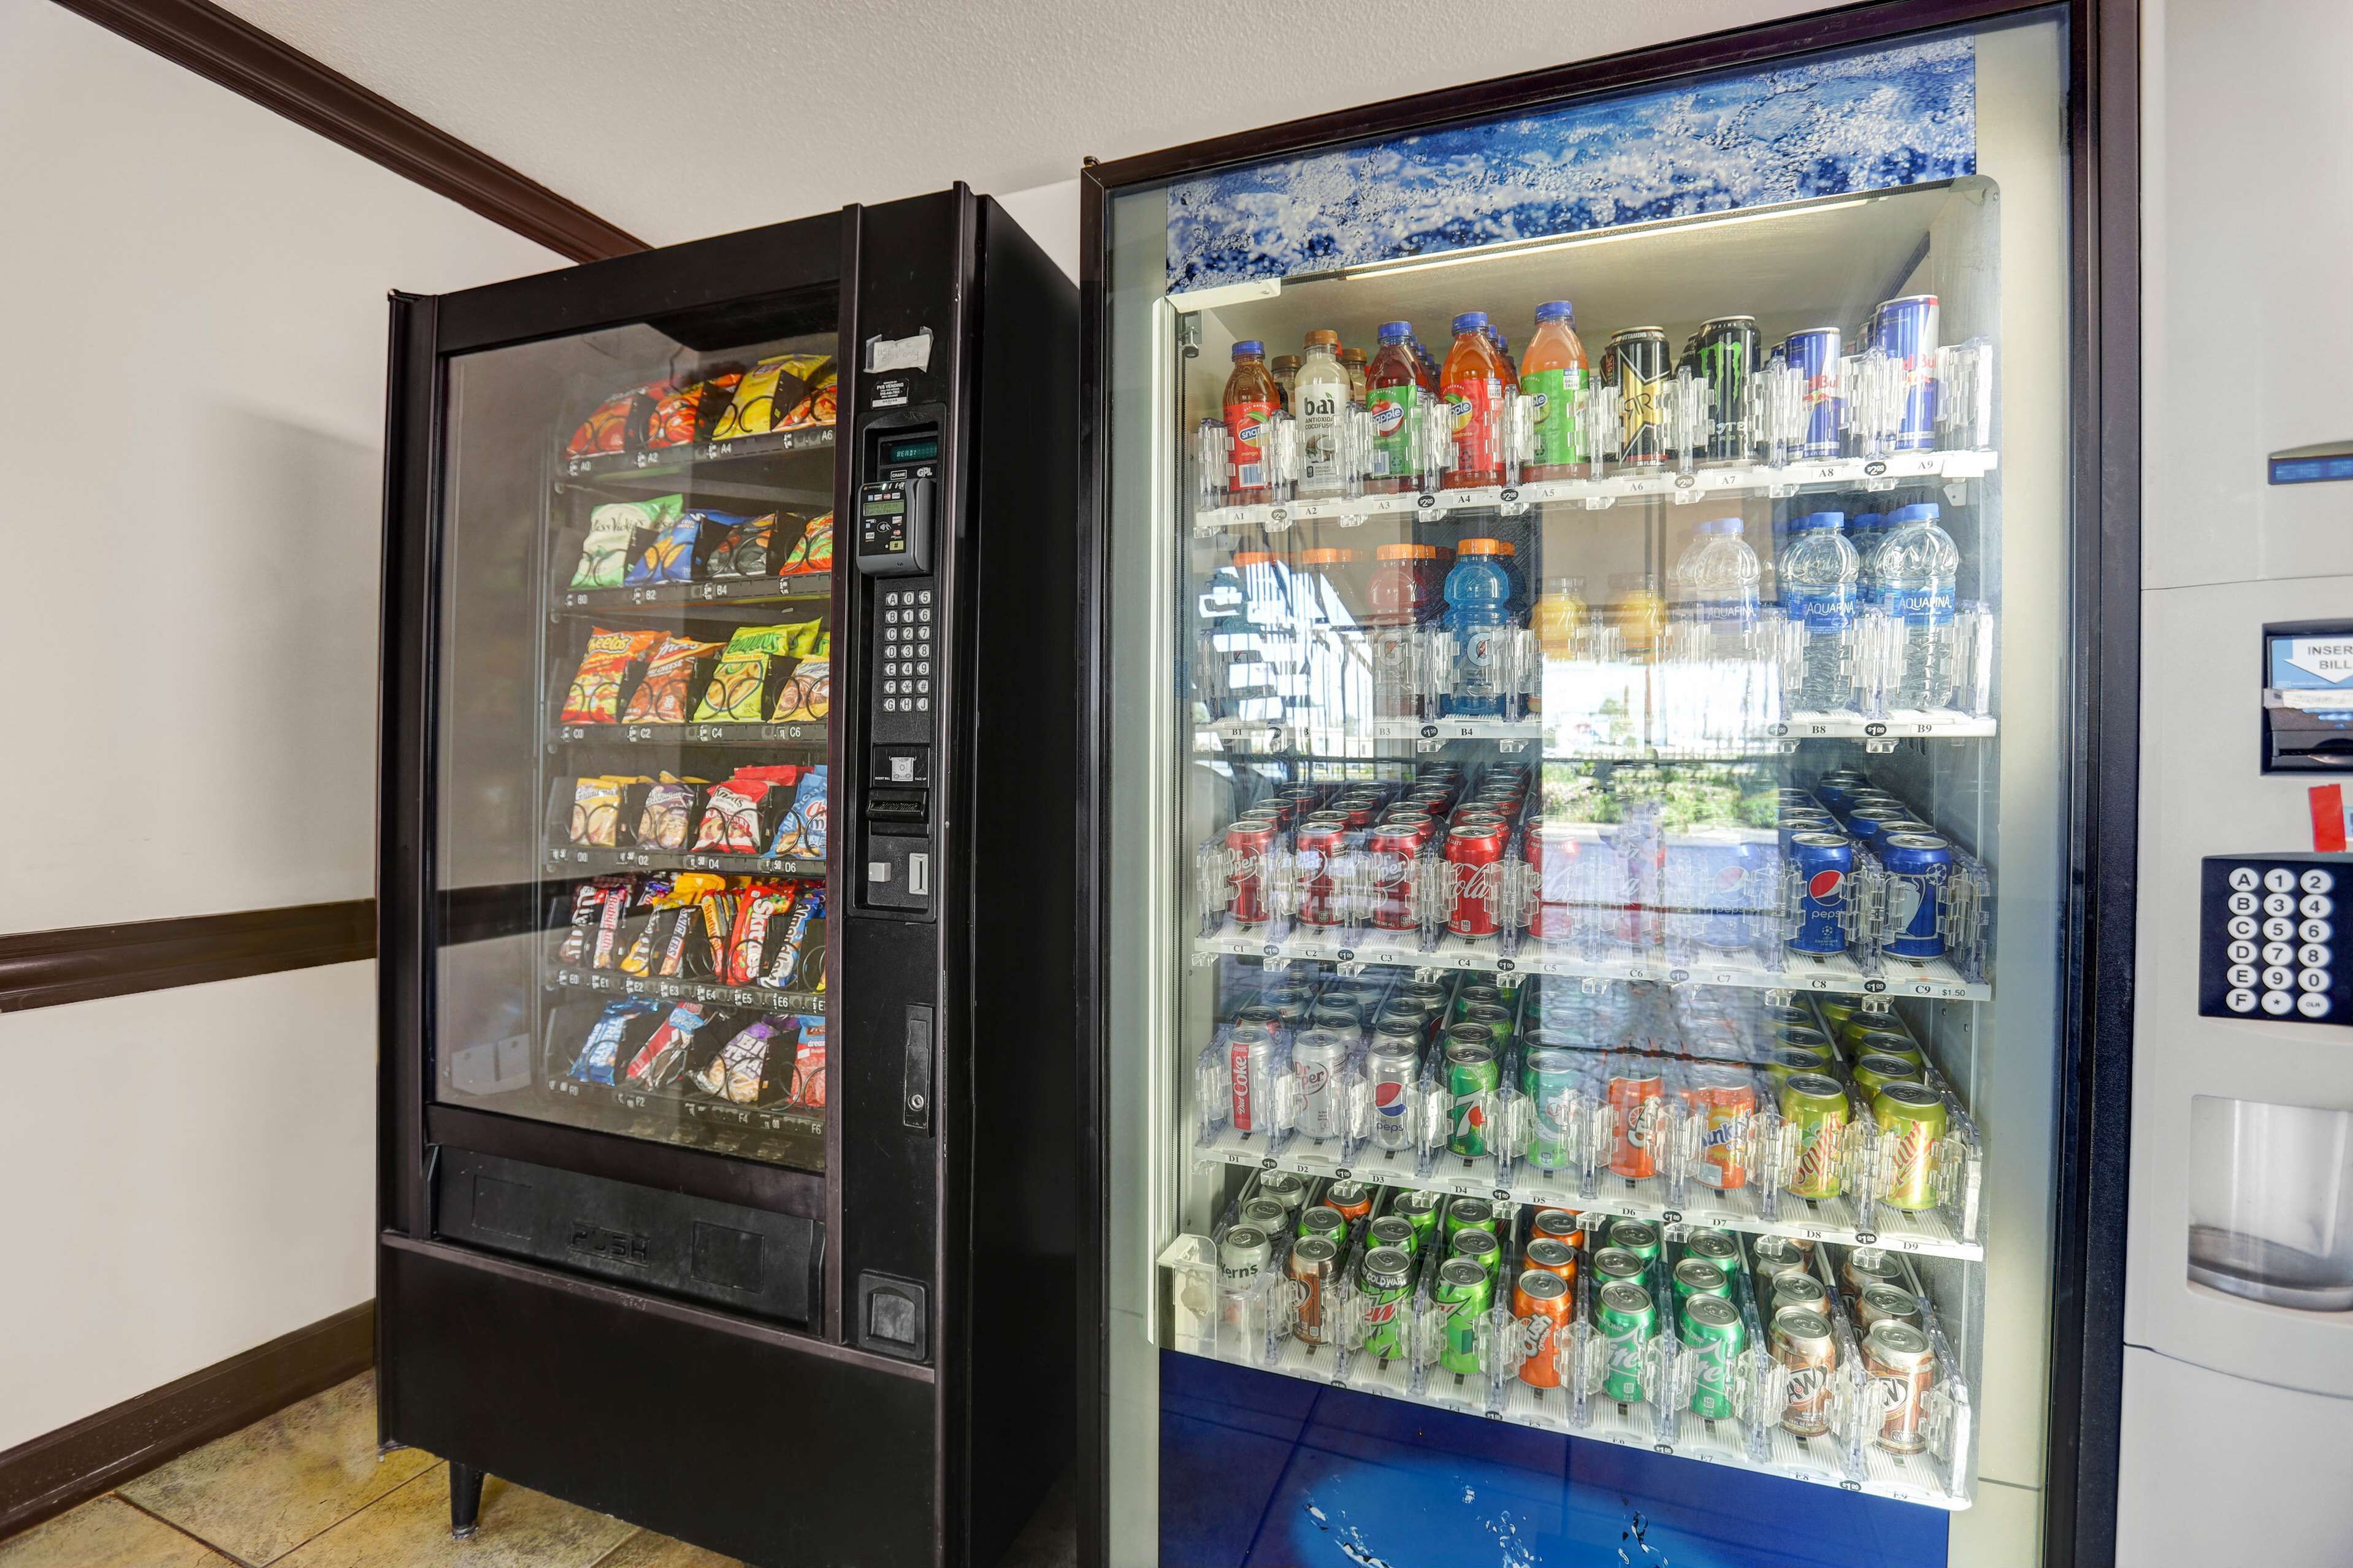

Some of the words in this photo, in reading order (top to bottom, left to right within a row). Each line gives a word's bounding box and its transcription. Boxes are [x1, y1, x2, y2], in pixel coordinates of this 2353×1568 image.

[1304, 397, 1335, 416] bai
[822, 430, 833, 441] A6
[721, 443, 732, 454] A4
[648, 453, 659, 463] A2
[1918, 461, 1934, 470] A9
[1819, 468, 1834, 477] A8
[1722, 476, 1735, 484] A7
[890, 595, 896, 603] A
[923, 593, 928, 602] 5
[1899, 595, 1953, 611] AQUAFINA
[1708, 606, 1756, 619] AQUAFINA
[1806, 600, 1856, 617] AQUAFINA
[890, 613, 895, 621] B
[906, 612, 911, 621] 1
[922, 611, 927, 619] 6
[889, 630, 895, 639] C
[906, 629, 911, 638] 2
[922, 629, 927, 638] 7
[889, 648, 894, 656] D
[906, 647, 911, 656] 3
[922, 646, 927, 655] 8
[889, 665, 893, 674] E
[905, 664, 909, 673] 4
[922, 664, 926, 673] 9
[2319, 660, 2351, 670] BILL
[889, 683, 893, 692] F
[888, 700, 893, 710] G
[905, 700, 909, 709] H
[921, 700, 926, 709] J
[640, 729, 651, 738] C2
[712, 728, 722, 738] C4
[790, 727, 801, 737] C6
[1812, 725, 1826, 734] B8
[1918, 724, 1932, 733] B9
[2237, 874, 2251, 887] A
[2275, 874, 2282, 887] 1
[2309, 876, 2320, 889] 2
[2237, 897, 2250, 910] B
[2273, 899, 2284, 912] 3
[2309, 900, 2320, 913] 4
[2236, 921, 2249, 935] C
[2273, 924, 2283, 936] 5
[2308, 925, 2319, 938] 6
[2236, 946, 2249, 958] D
[2271, 947, 2283, 960] 7
[2308, 949, 2319, 962] 8
[1458, 958, 1471, 967] C4
[1717, 974, 1731, 982] C7
[2236, 969, 2248, 982] E
[2272, 972, 2283, 984] 9
[600, 977, 609, 988] E1
[634, 982, 643, 992] E2
[1812, 980, 1826, 989] C8
[670, 985, 679, 996] E3
[1915, 985, 1931, 994] C9
[1942, 989, 1965, 997] $1.50
[706, 990, 716, 1000] E4
[742, 993, 752, 1004] E5
[2236, 993, 2248, 1006] F
[778, 997, 788, 1007] E6
[1234, 1055, 1247, 1096] Coke
[739, 1114, 748, 1123] F4
[811, 1124, 822, 1134] F6
[1367, 1273, 1386, 1285] COLD
[1386, 1277, 1404, 1287] WAR
